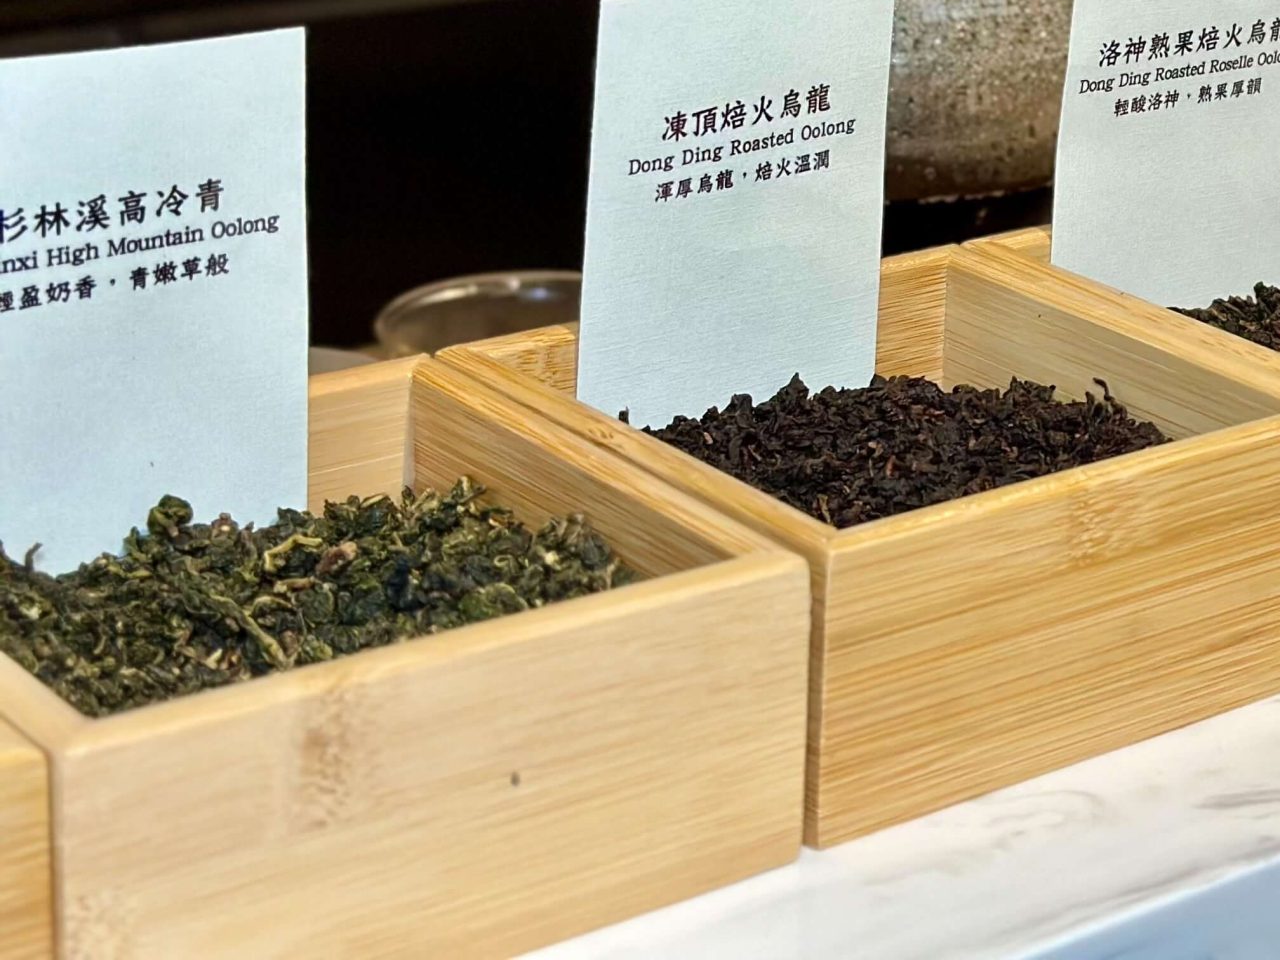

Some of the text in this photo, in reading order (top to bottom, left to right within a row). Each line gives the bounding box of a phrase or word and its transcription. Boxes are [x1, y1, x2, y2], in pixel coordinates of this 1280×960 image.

[1079, 76, 1115, 94] Dong
[1119, 71, 1151, 88] Ding
[1154, 61, 1205, 82] Roasted
[1209, 55, 1253, 74] Roselle
[662, 83, 831, 142] 凍頂焙火烏龍
[628, 117, 856, 176] Dong Ding Roasted Oolong
[0, 178, 224, 242] 杉林溪高冷青
[0, 215, 280, 275] nxi High Mountain Oolong
